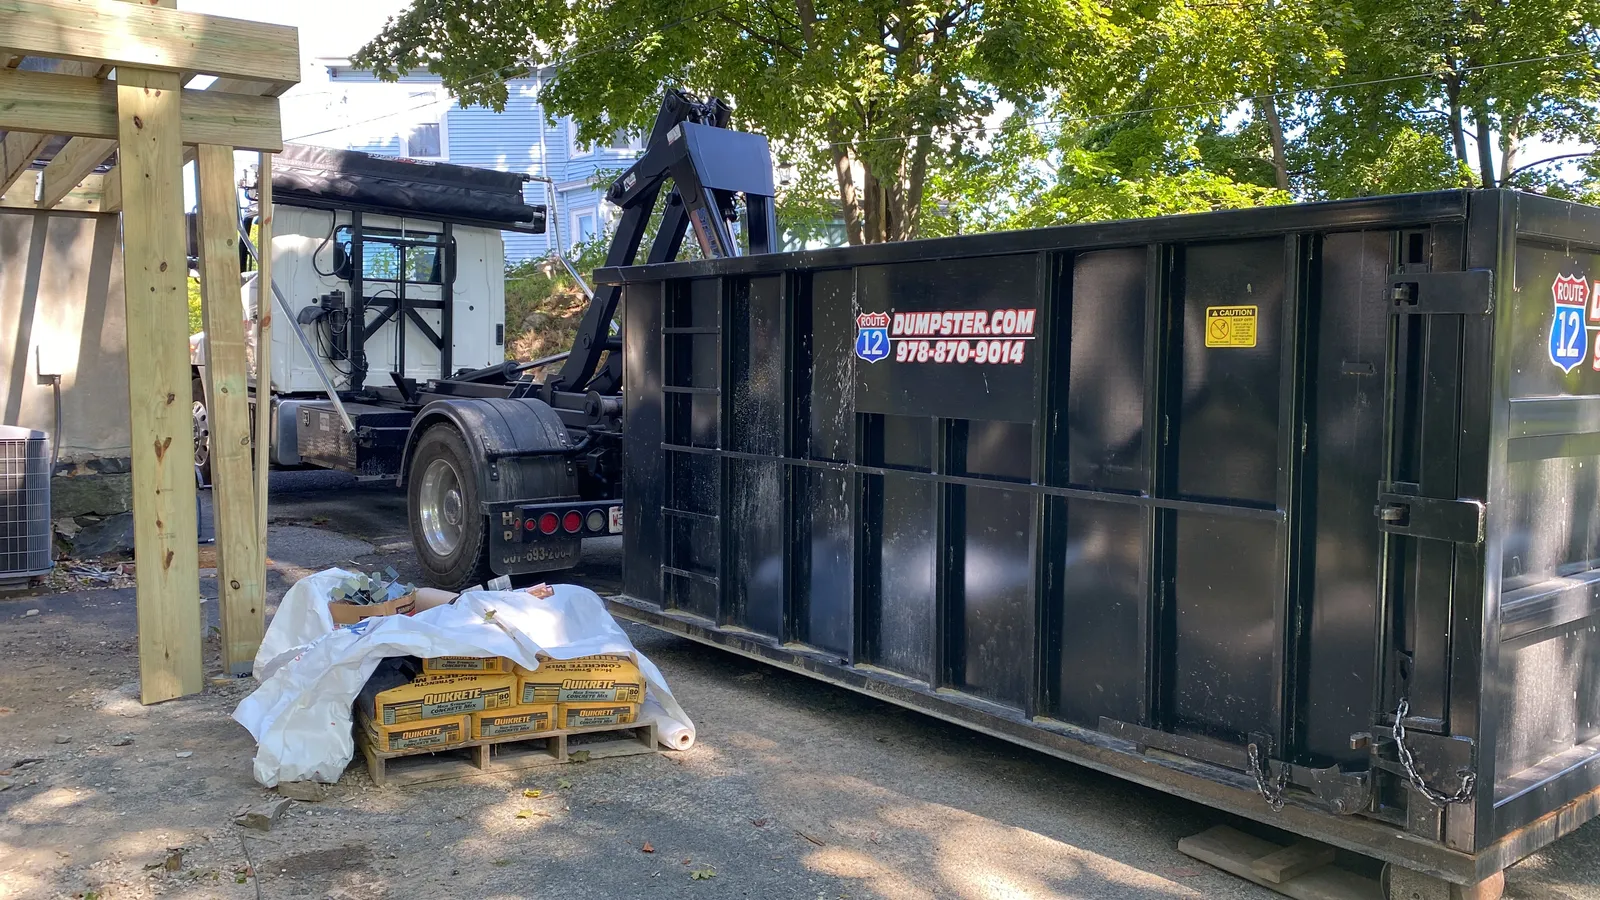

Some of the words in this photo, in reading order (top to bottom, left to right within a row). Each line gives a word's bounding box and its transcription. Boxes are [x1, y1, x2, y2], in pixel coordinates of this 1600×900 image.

[1557, 282, 1584, 302] ROUTE
[860, 316, 885, 327] ROUTE
[891, 308, 1037, 336] DUMPSTER.COM
[862, 330, 883, 355] 12
[1556, 311, 1580, 357] 12
[896, 340, 1026, 364] 978-870-9014
[562, 679, 616, 690] QUIKRETE
[424, 688, 482, 705] QUIKRETE
[494, 716, 531, 726] QUIKRETE
[580, 709, 614, 717] QUIKRETE
[402, 728, 442, 740] QUIKRETE
